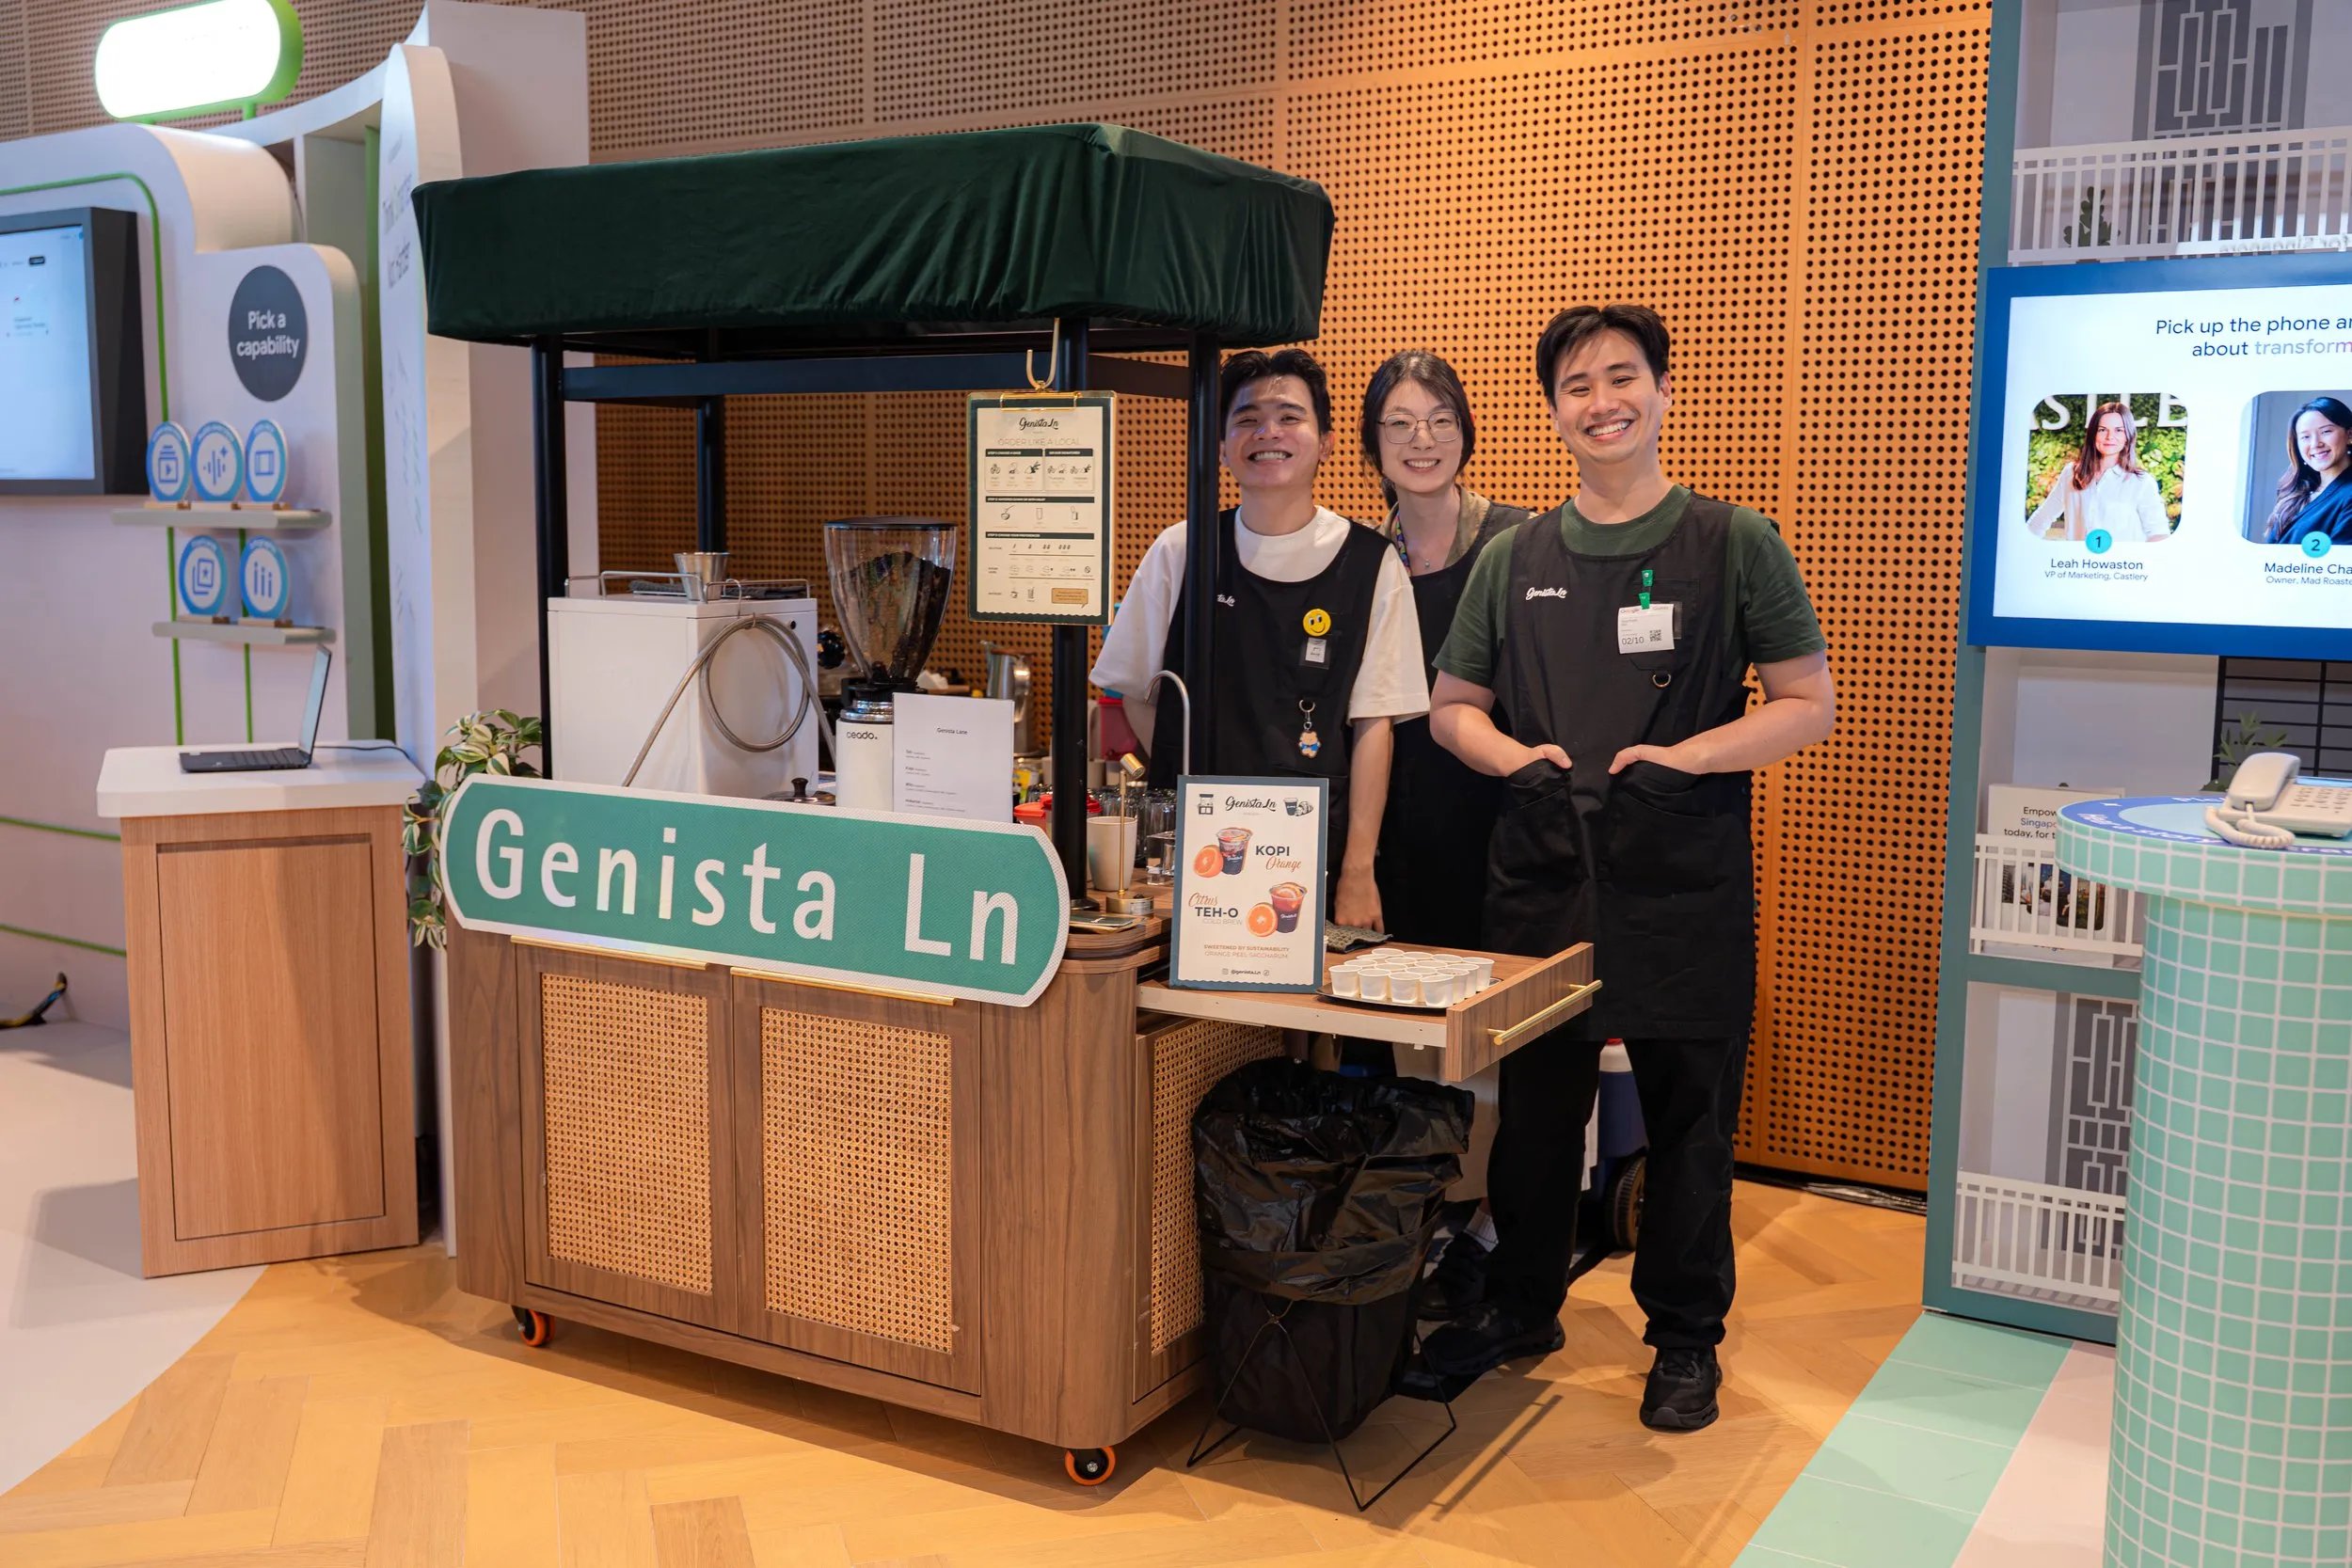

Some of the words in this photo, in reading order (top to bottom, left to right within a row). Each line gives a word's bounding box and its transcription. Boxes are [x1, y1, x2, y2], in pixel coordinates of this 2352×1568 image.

[247, 309, 276, 330] Pick
[277, 312, 287, 328] a
[2155, 318, 2195, 334] Pick
[2200, 321, 2224, 337] up
[2230, 317, 2262, 332] the
[2266, 316, 2330, 335] phone
[236, 335, 300, 360] capability
[2192, 341, 2249, 356] about
[1019, 417, 1048, 431] Genista
[2095, 536, 2102, 548] 1
[2311, 539, 2321, 551] 2
[2050, 559, 2078, 568] Leah
[2082, 559, 2144, 570] Howaston
[2264, 562, 2324, 574] Madeline
[2068, 571, 2112, 581] Marketing,
[2113, 572, 2149, 582] Castlery
[2301, 577, 2321, 585] Mad
[1621, 636, 1645, 645] 02/10
[1225, 796, 1263, 812] Genista
[2023, 806, 2058, 816] Empow
[2020, 817, 2058, 829] Singap
[2004, 829, 2033, 838] today,
[2035, 830, 2050, 839] for
[1255, 846, 1290, 856] KOPI
[1265, 856, 1302, 873] Orange
[475, 808, 835, 941] Genista
[904, 852, 1020, 965] Ln
[1188, 892, 1218, 907] Citrus
[1195, 907, 1239, 918] TEH-O
